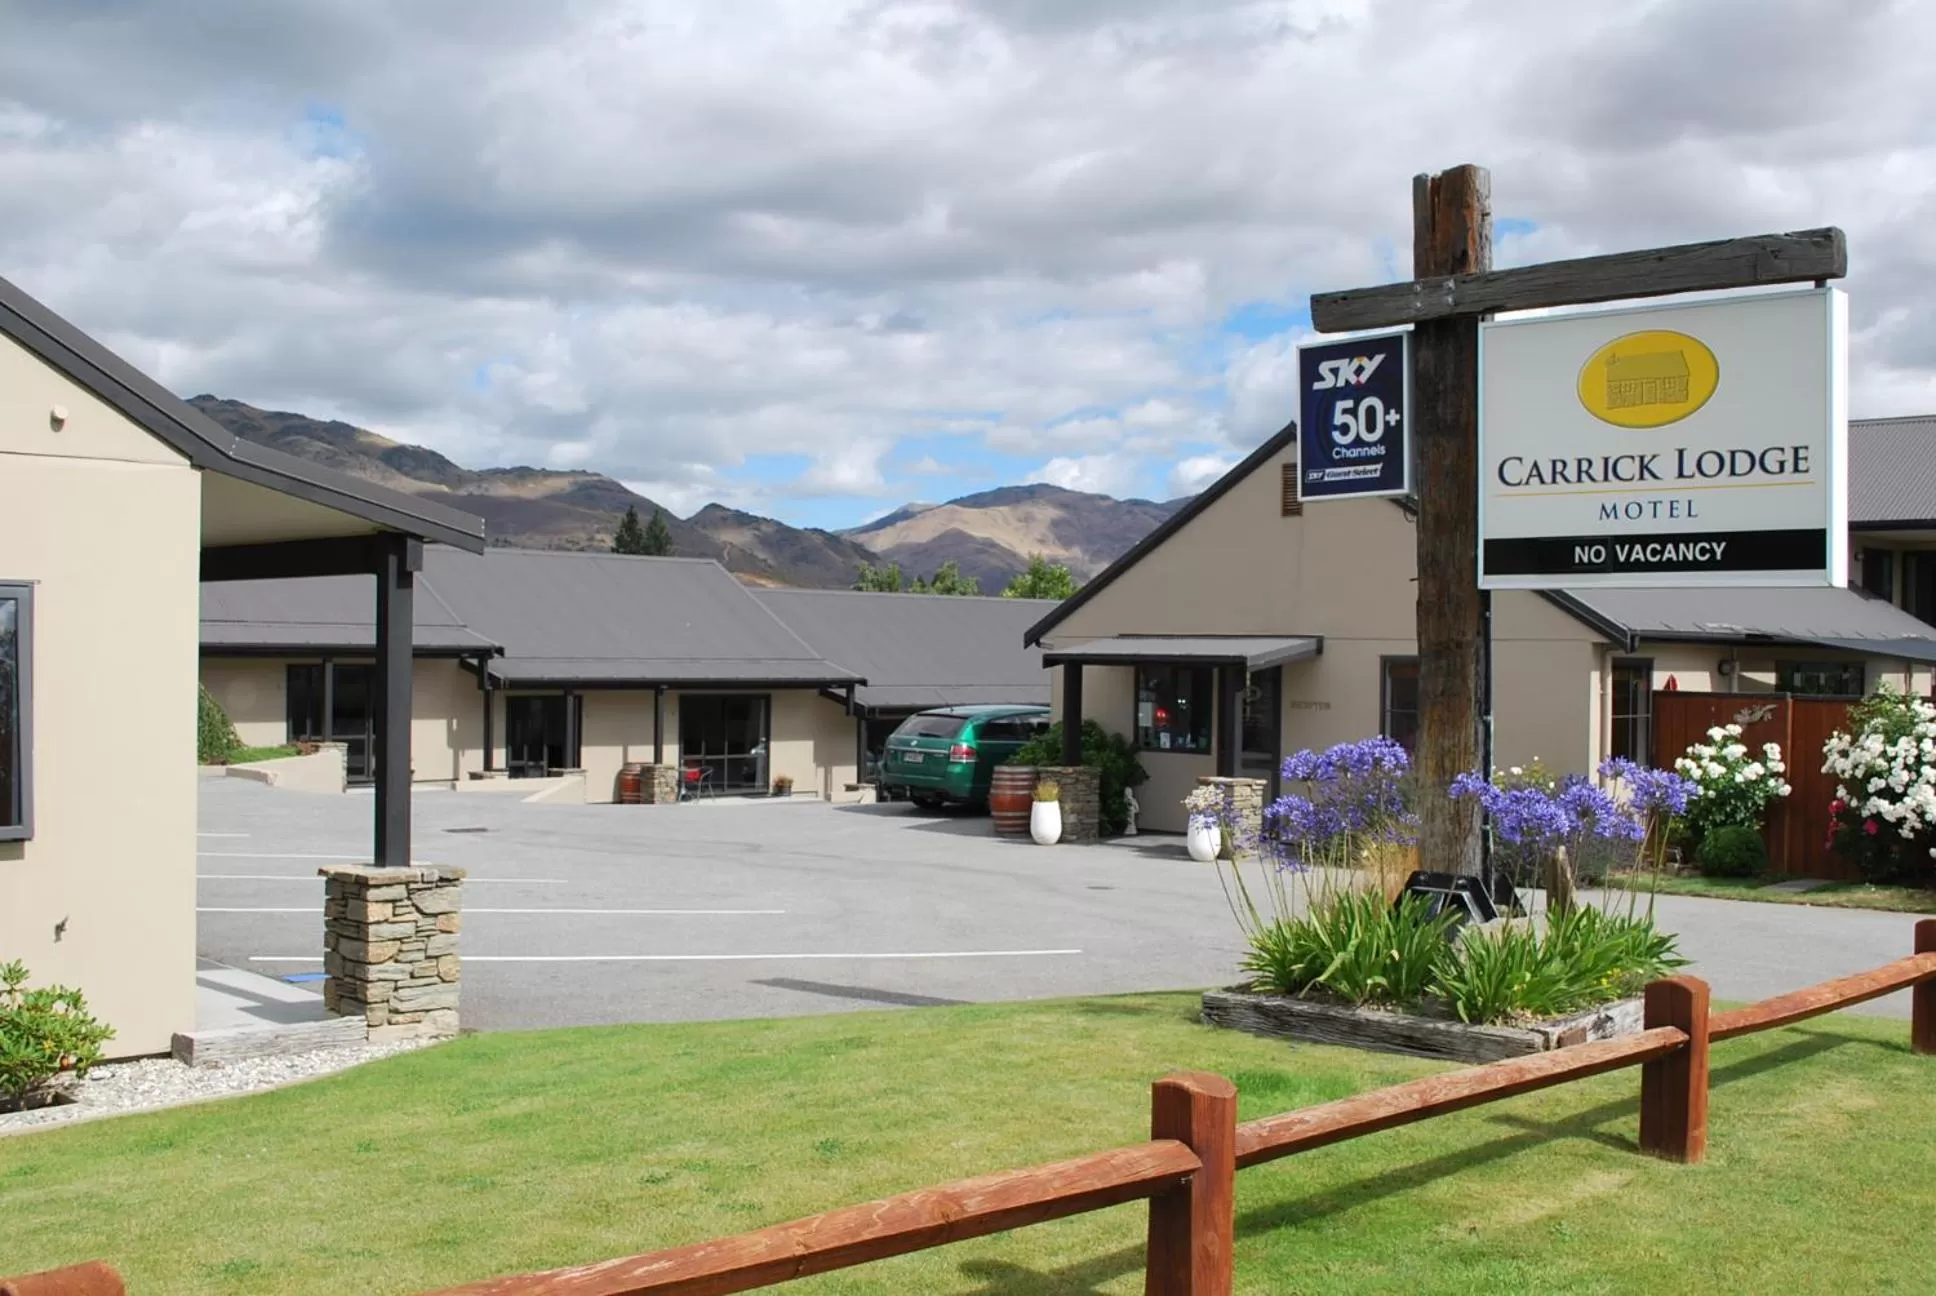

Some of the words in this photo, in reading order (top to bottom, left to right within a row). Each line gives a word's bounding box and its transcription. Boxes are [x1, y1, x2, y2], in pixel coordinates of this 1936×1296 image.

[1312, 353, 1386, 390] SKY
[1331, 396, 1401, 445] 50+
[1332, 444, 1386, 459] Channels
[1497, 453, 1664, 487] CARRICK
[1675, 445, 1811, 479] LODGE
[1598, 499, 1699, 521] MOTEL
[1574, 544, 1607, 564] NO
[1615, 541, 1727, 563] VACANCY
